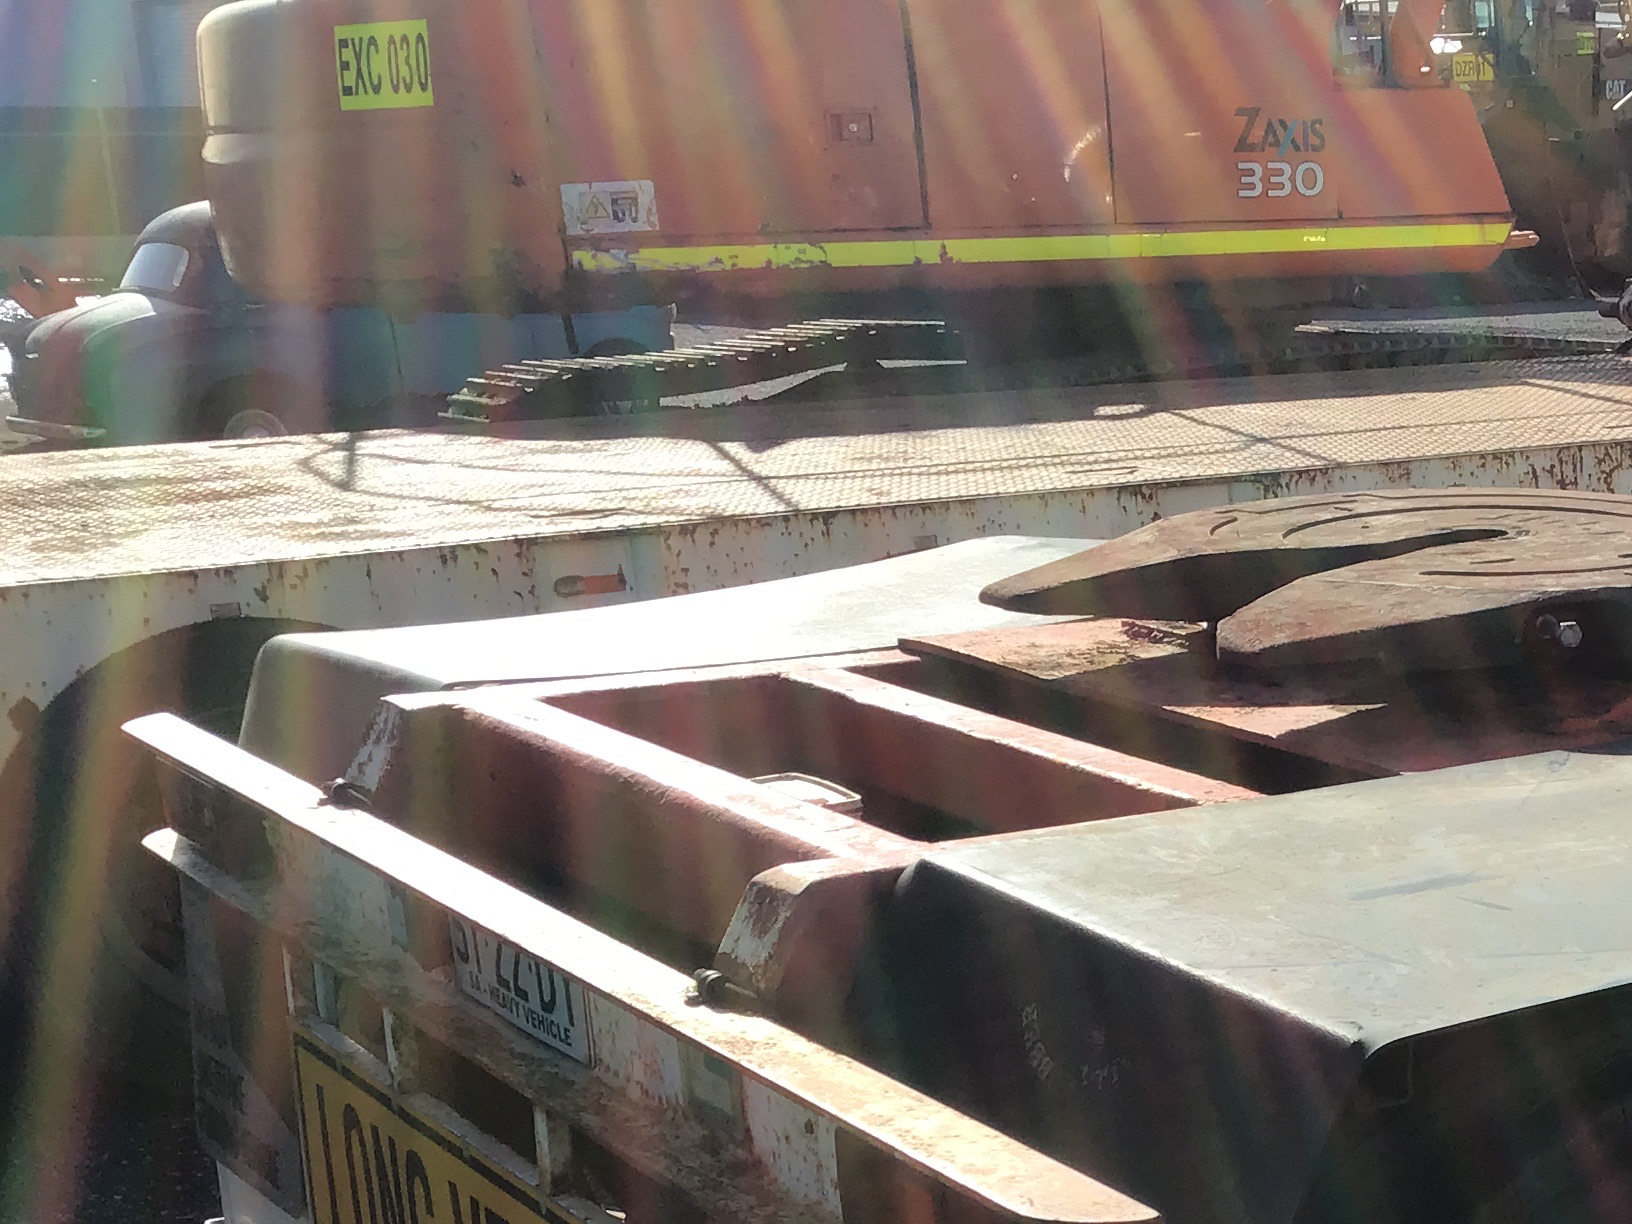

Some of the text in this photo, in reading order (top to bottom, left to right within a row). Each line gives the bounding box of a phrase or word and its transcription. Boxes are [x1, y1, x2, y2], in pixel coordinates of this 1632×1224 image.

[338, 33, 428, 96] EXC 030
[1606, 79, 1626, 99] CAT
[1233, 107, 1326, 157] ZAXIS
[1237, 161, 1324, 197] 330
[488, 982, 520, 1018] HEAVY
[522, 1004, 573, 1048] VEHICLE
